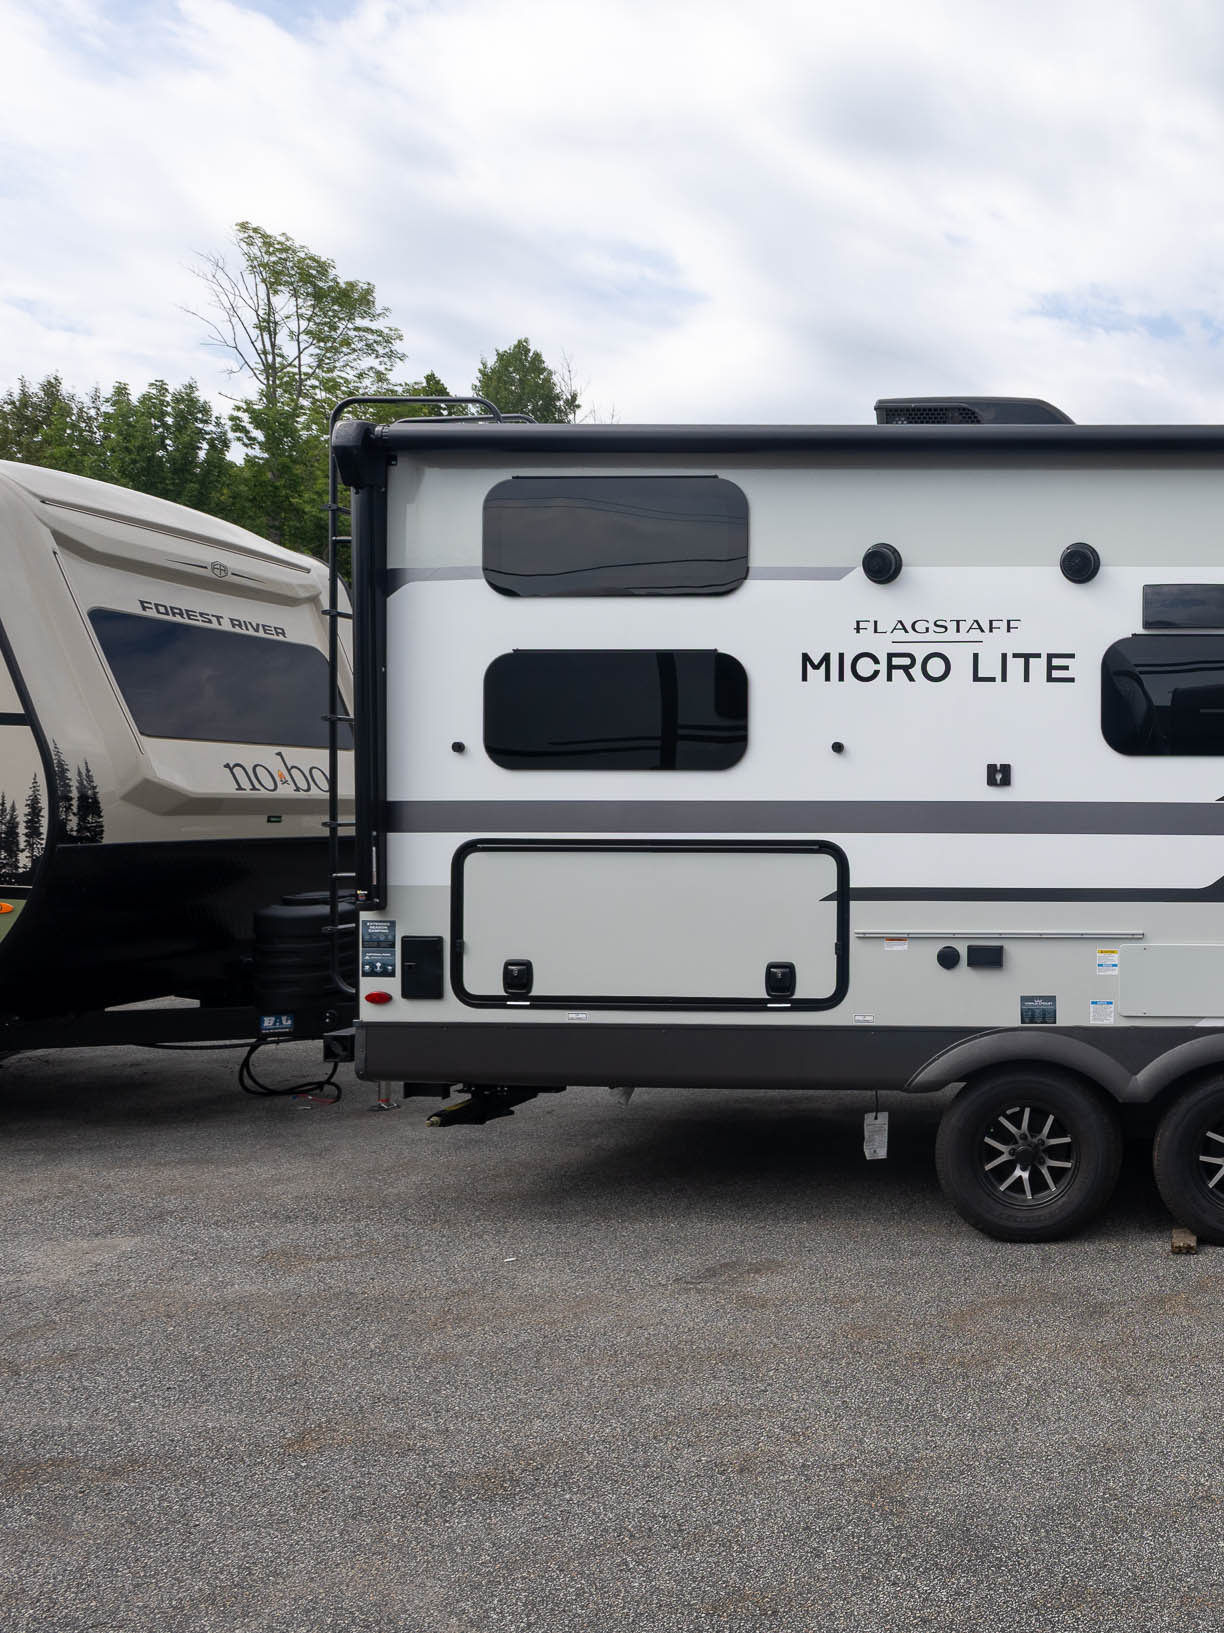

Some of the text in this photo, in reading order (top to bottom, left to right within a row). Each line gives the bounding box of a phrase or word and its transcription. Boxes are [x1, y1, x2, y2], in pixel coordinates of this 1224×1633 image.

[138, 599, 288, 639] FOREST RIVER
[853, 618, 1022, 634] FLAGSTAFF
[801, 651, 1076, 683] MICRO LITE
